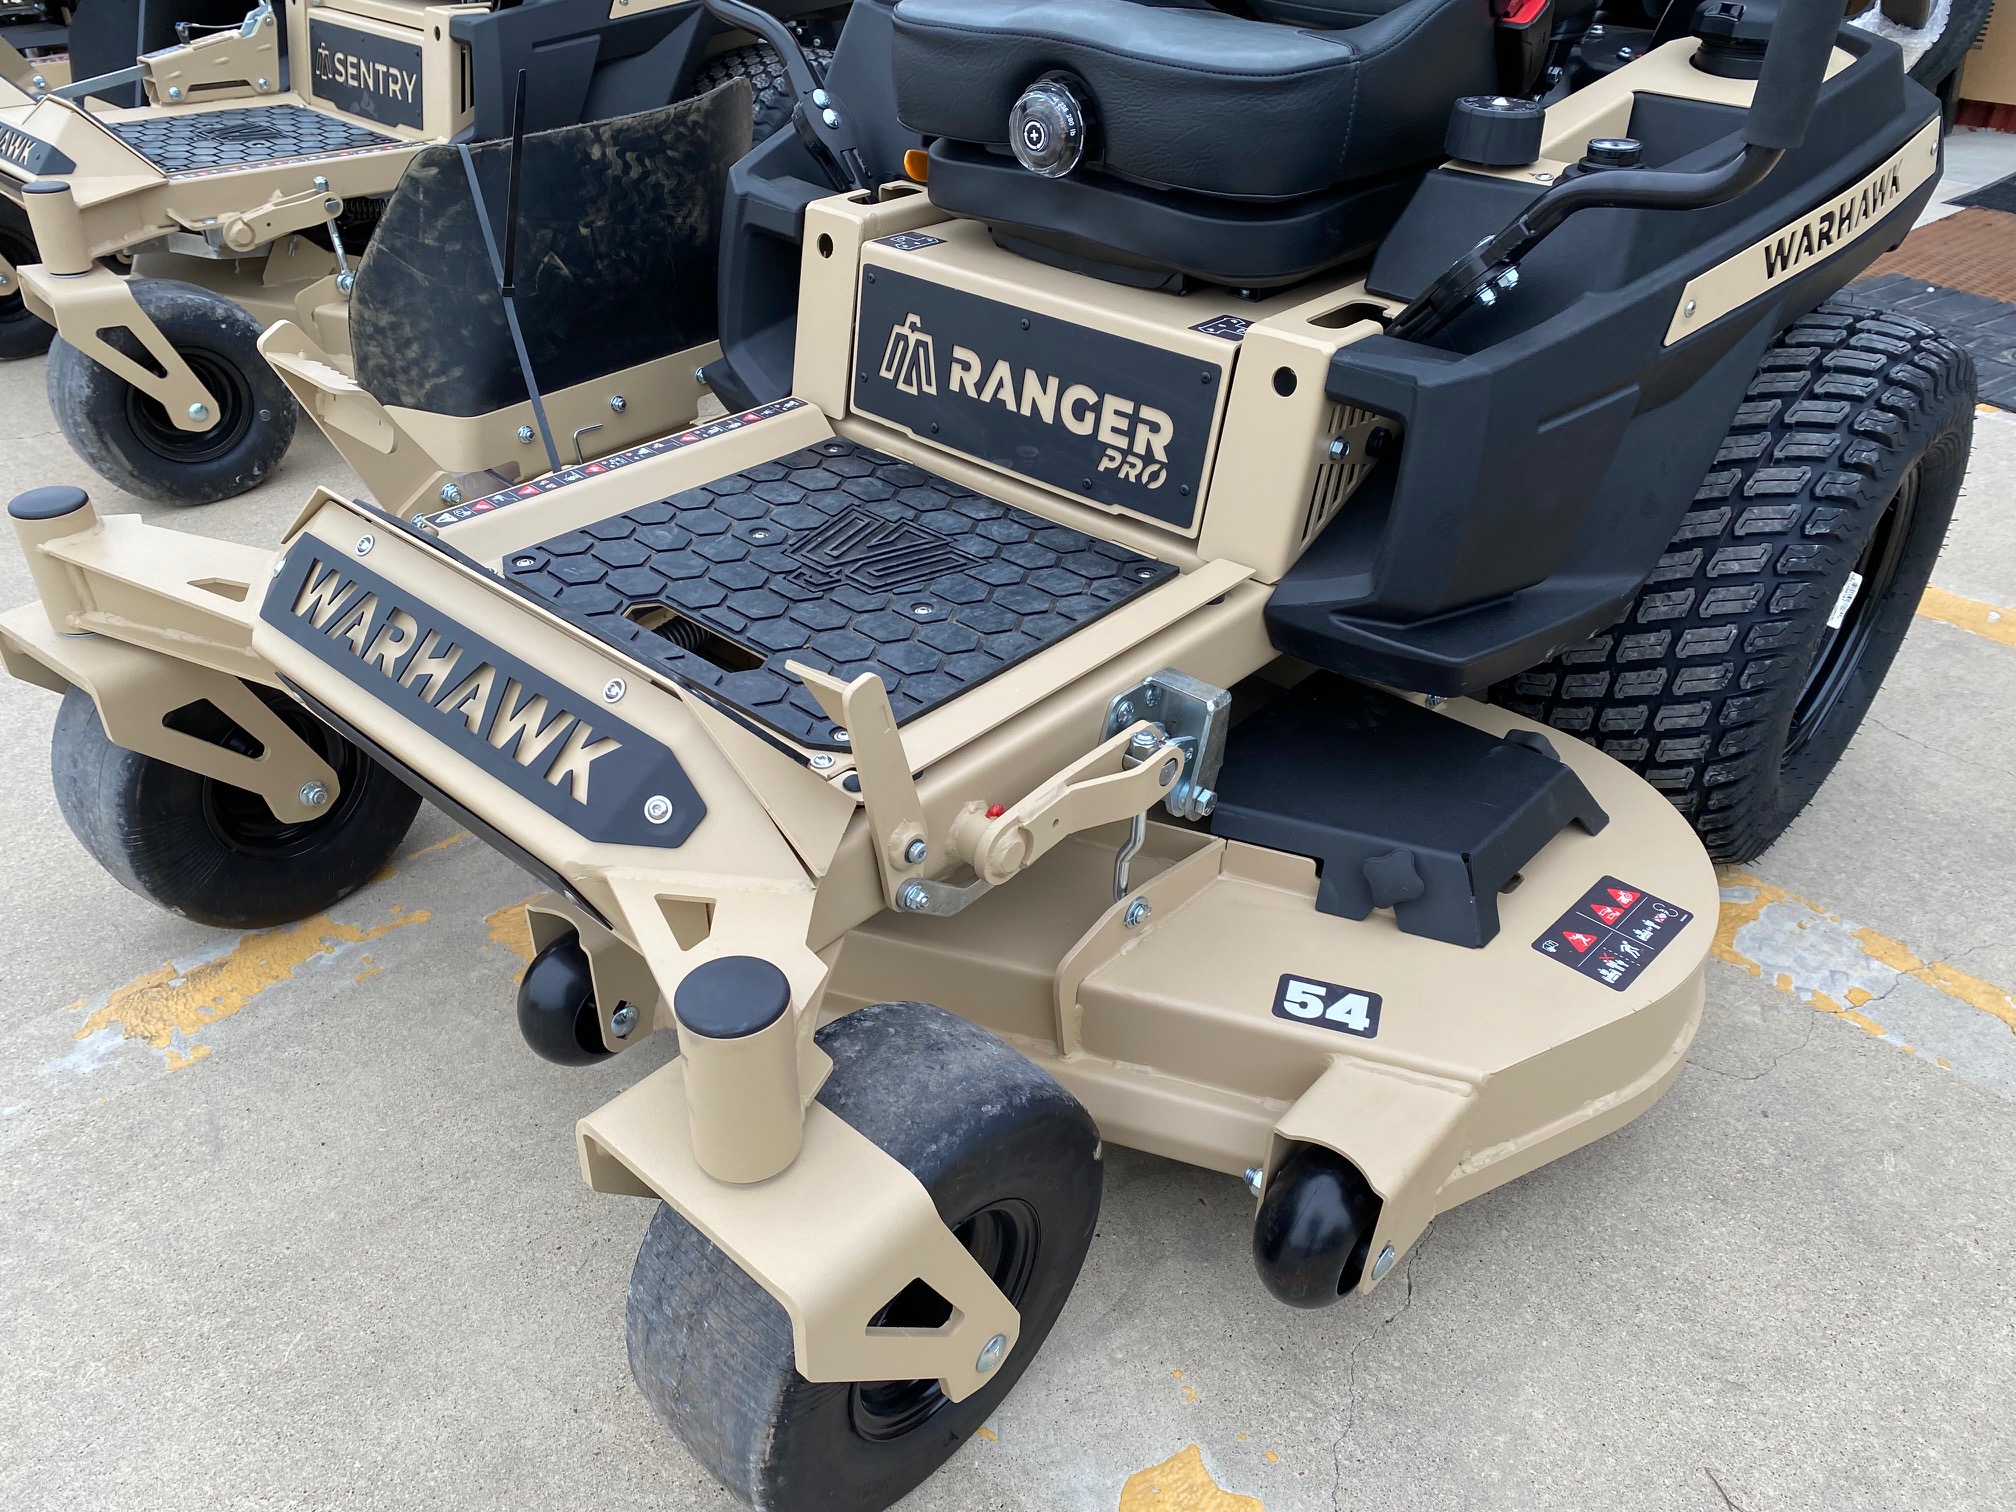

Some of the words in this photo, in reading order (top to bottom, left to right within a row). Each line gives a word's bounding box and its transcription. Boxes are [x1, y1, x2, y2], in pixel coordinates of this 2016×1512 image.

[334, 52, 418, 103] SENTRY
[0, 126, 36, 165] AWK
[1764, 158, 1903, 280] WARHAWK
[949, 345, 1174, 463] RANGER
[1098, 448, 1168, 489] PRO
[290, 557, 623, 806] WARHAWK
[1283, 980, 1370, 1031] 54
